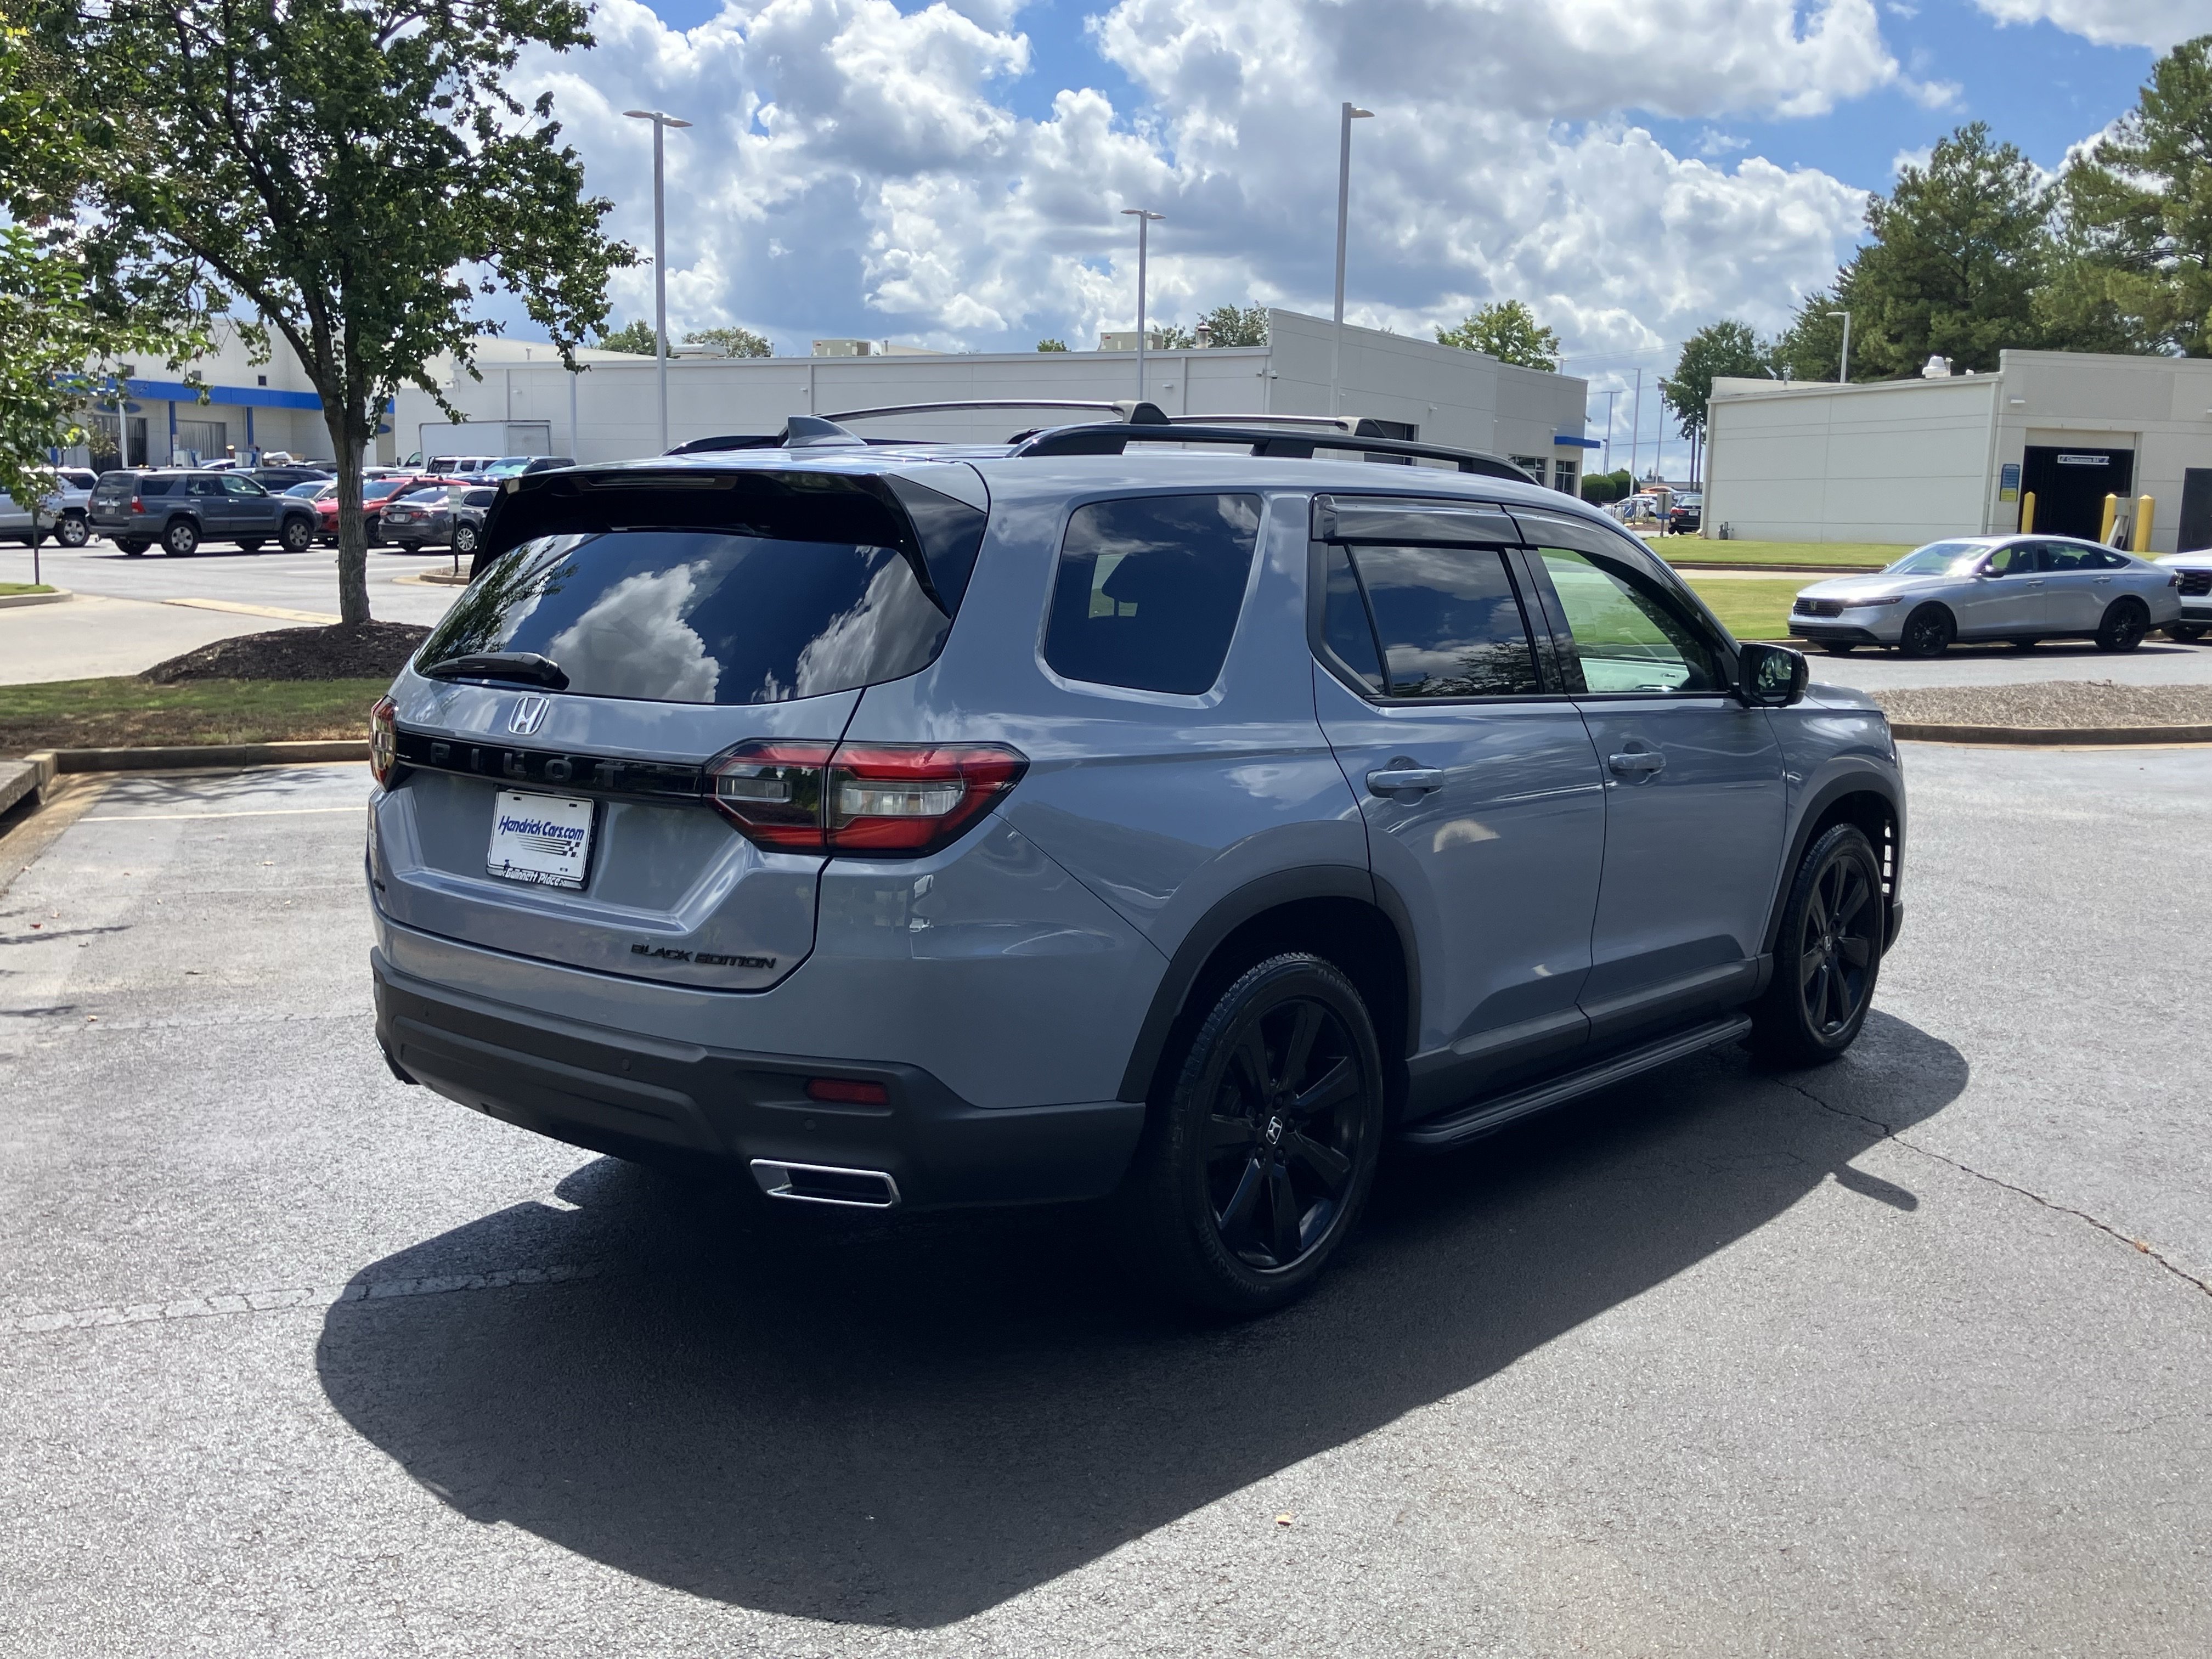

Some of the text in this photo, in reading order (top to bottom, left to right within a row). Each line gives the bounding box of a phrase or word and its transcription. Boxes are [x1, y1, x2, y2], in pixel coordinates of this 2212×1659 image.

[431, 742, 625, 787] PILOT
[537, 872, 561, 886] Place
[630, 943, 777, 969] BLACK EDITION
